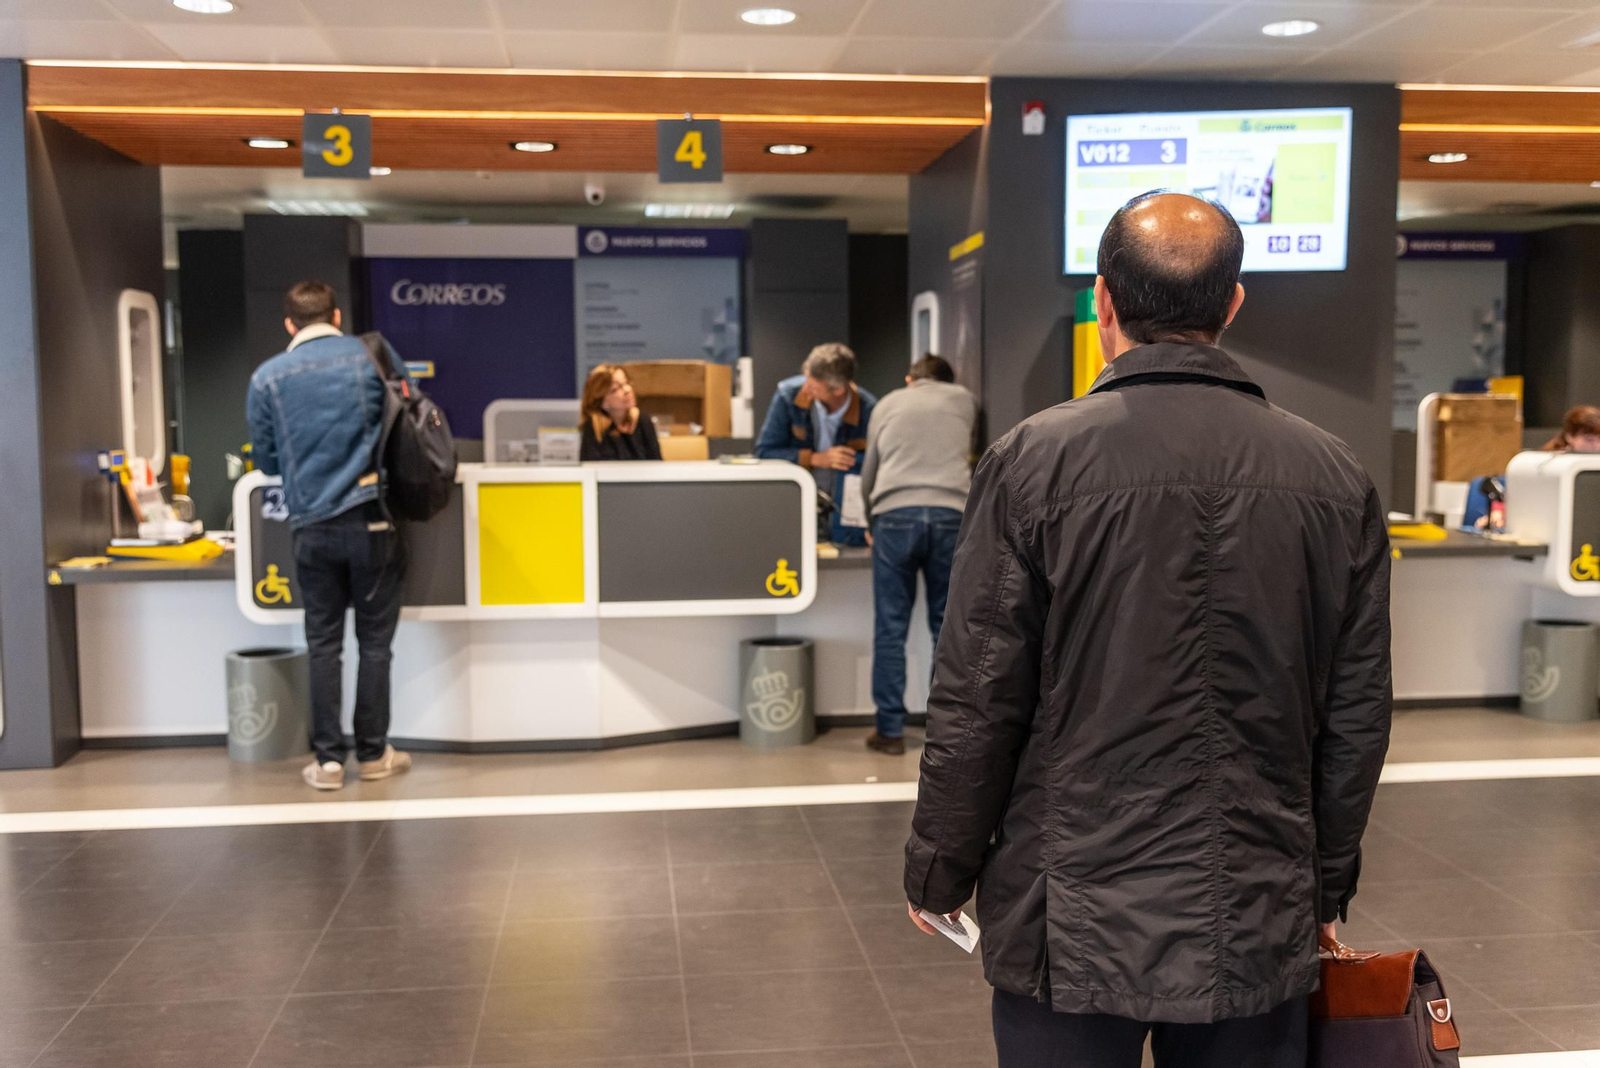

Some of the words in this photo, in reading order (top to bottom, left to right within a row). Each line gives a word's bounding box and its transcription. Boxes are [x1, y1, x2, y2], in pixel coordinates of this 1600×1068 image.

[323, 125, 353, 166] 3
[675, 131, 706, 169] 4
[1080, 144, 1130, 163] V012
[1160, 140, 1177, 163] 3
[390, 279, 507, 305] CORREOS
